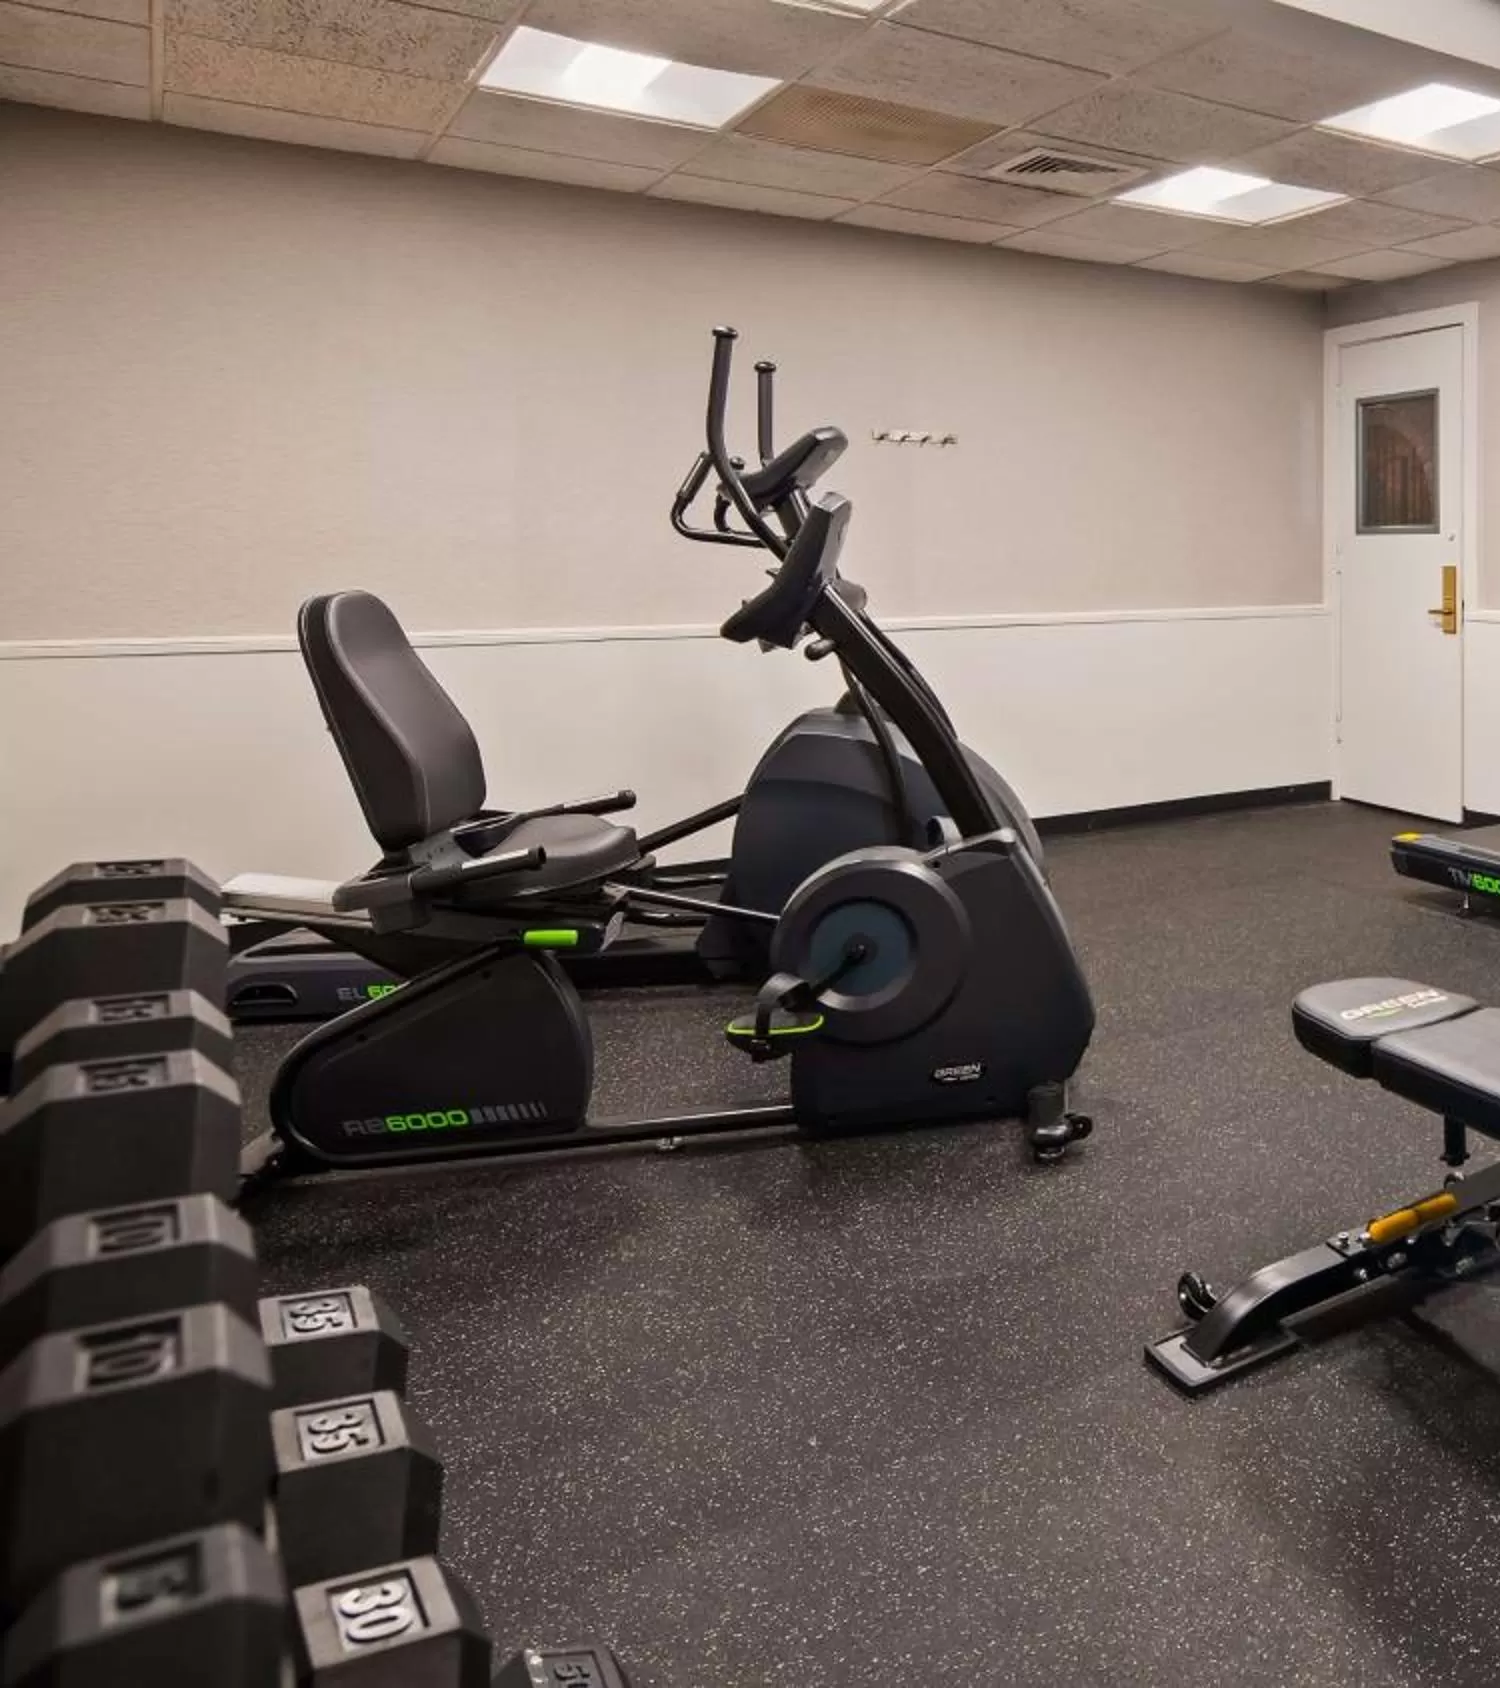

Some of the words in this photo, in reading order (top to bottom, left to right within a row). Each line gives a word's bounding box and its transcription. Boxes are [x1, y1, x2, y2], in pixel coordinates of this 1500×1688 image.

[289, 1301, 343, 1333] 35
[87, 1334, 174, 1388] 10
[307, 1410, 369, 1454] 35
[338, 1580, 414, 1643] 30
